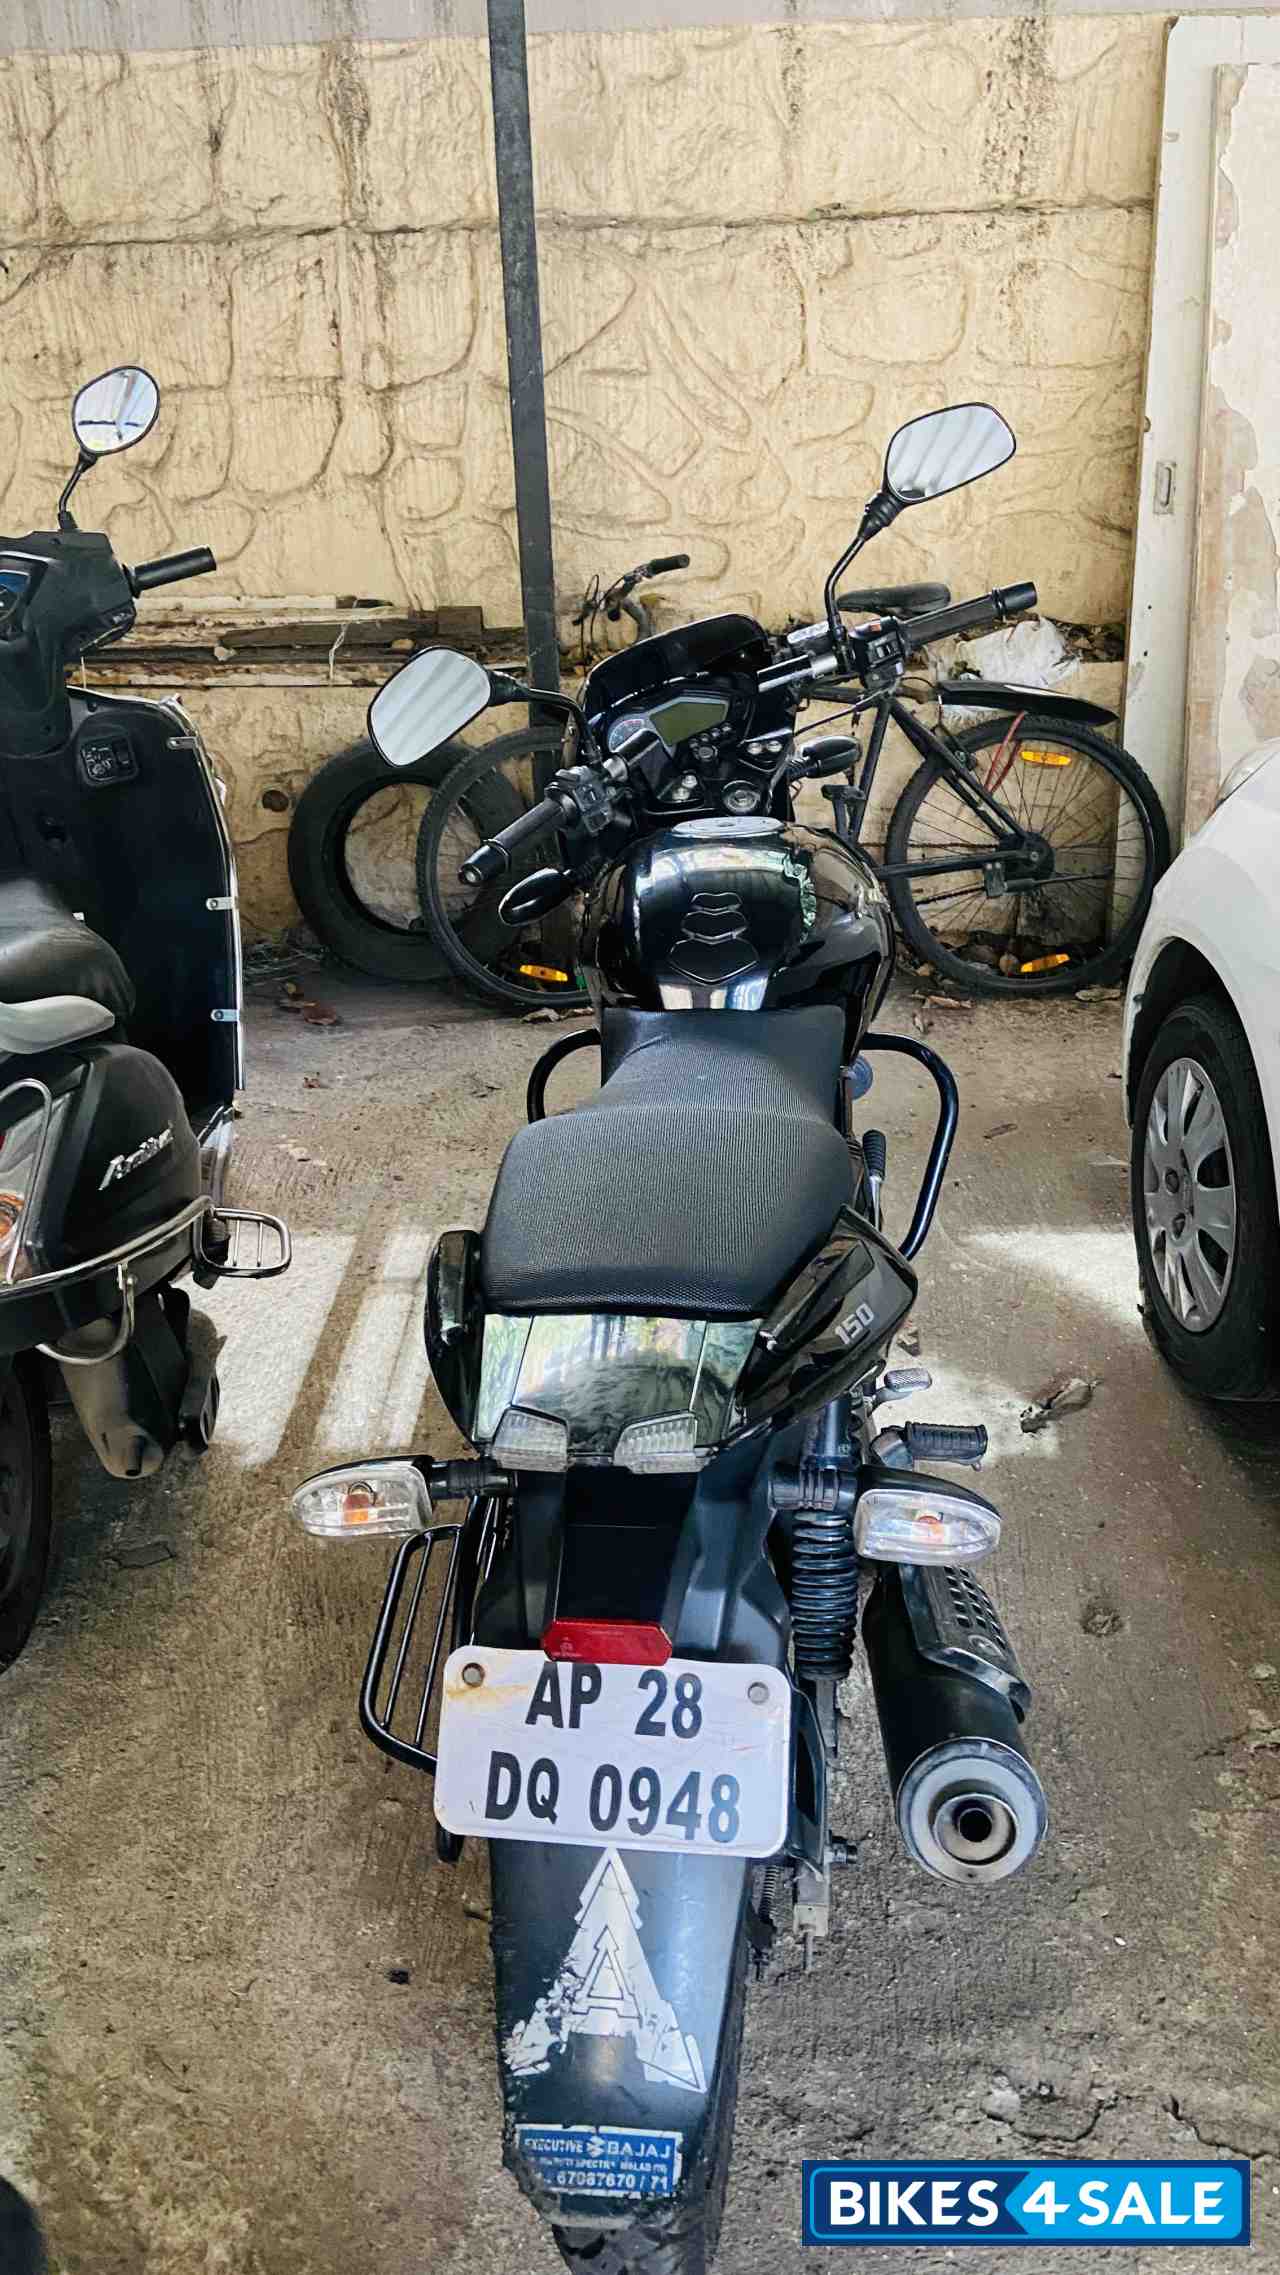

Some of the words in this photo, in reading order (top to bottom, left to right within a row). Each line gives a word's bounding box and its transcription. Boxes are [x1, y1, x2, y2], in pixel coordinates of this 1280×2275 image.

[834, 1302, 875, 1345] 150
[525, 1661, 602, 1729] AP
[634, 1669, 703, 1739] 28
[484, 1751, 560, 1825] DQ
[589, 1763, 741, 1843] 0948
[607, 2140, 671, 2159] BAJAJ
